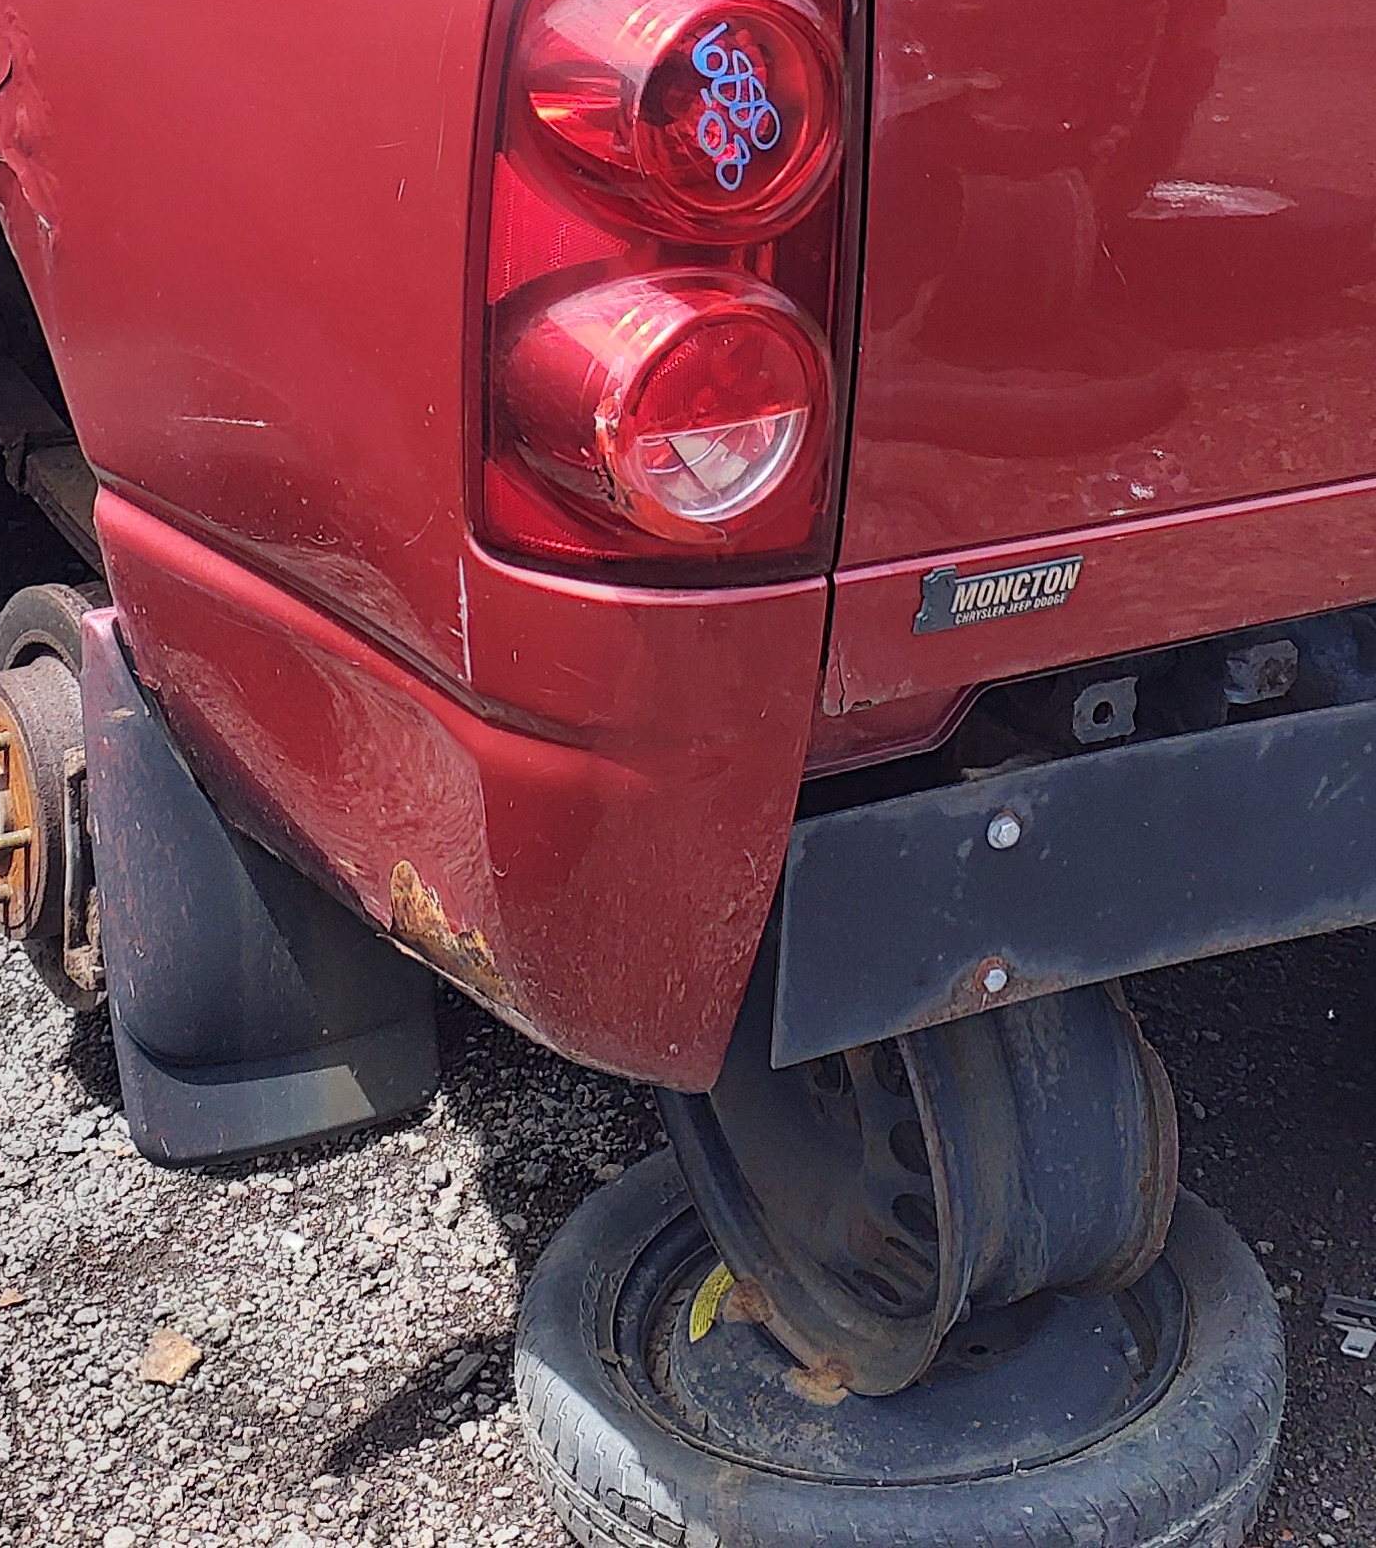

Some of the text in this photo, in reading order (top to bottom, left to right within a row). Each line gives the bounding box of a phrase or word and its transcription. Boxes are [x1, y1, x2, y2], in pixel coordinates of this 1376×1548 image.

[950, 562, 1081, 613] MONCTON
[955, 592, 1067, 625] CHRYSLER JEEP DODGE
